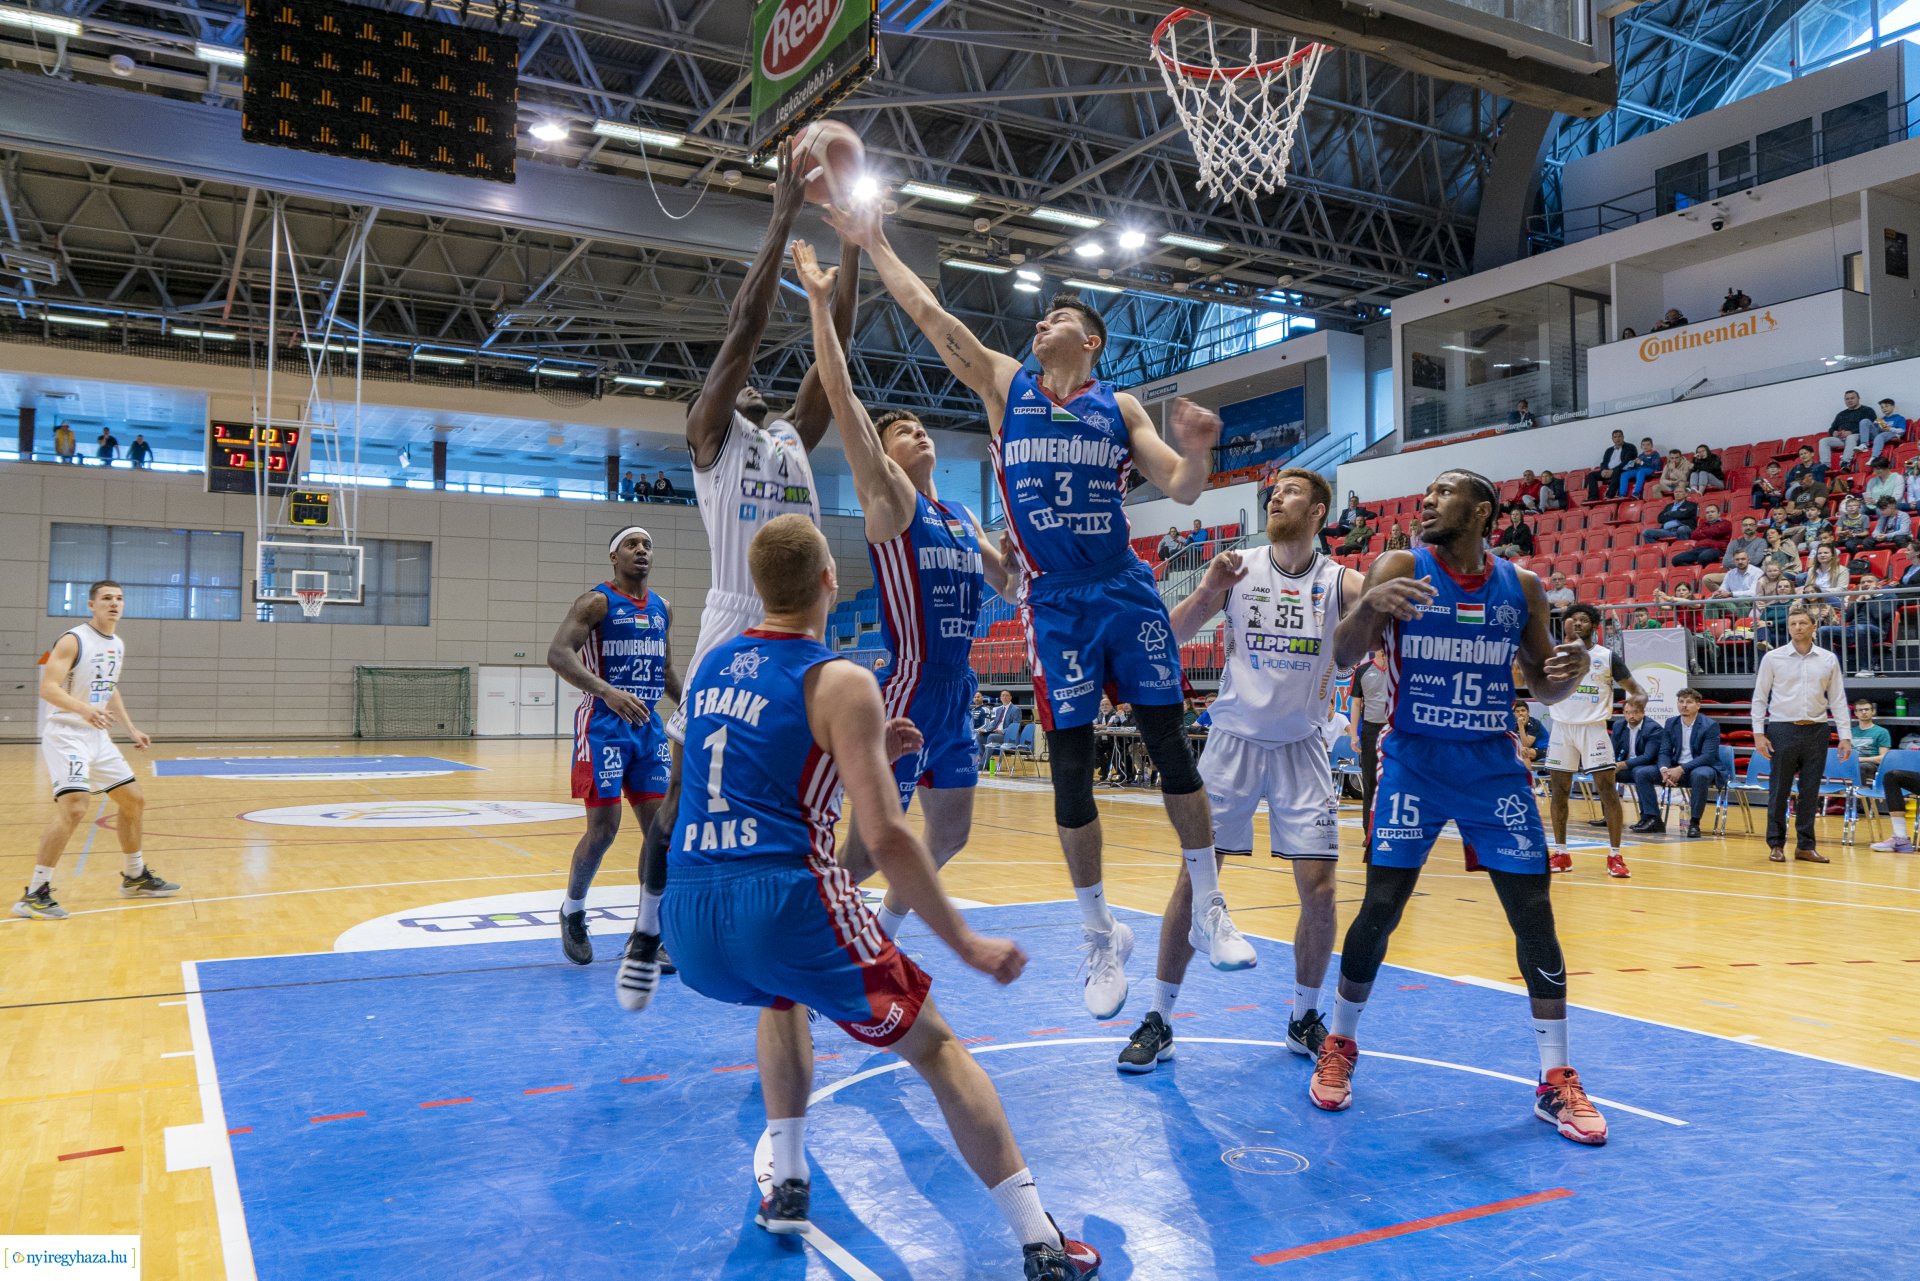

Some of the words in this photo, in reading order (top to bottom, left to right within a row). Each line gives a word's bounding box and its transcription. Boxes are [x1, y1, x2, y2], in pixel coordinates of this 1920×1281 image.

[776, 69, 825, 124] Legközelebb
[1639, 315, 1757, 362] Continental
[1552, 409, 1588, 423] Continental
[778, 454, 788, 477] 4
[1016, 477, 1043, 491] MVM
[1055, 472, 1073, 506] 3
[1089, 480, 1116, 490] MVM
[1252, 586, 1270, 594] JAKO
[1274, 605, 1304, 629] 35
[631, 658, 652, 681] 23
[1062, 651, 1084, 682] 3
[1262, 658, 1311, 671] HÜBNER
[1410, 674, 1446, 686] MVM
[1451, 672, 1483, 706] 15
[693, 687, 769, 727] FRANK
[69, 761, 83, 776] 12
[603, 746, 622, 769] 23
[702, 724, 731, 813] 1
[1389, 792, 1420, 827] 15
[682, 817, 758, 852] PAKS
